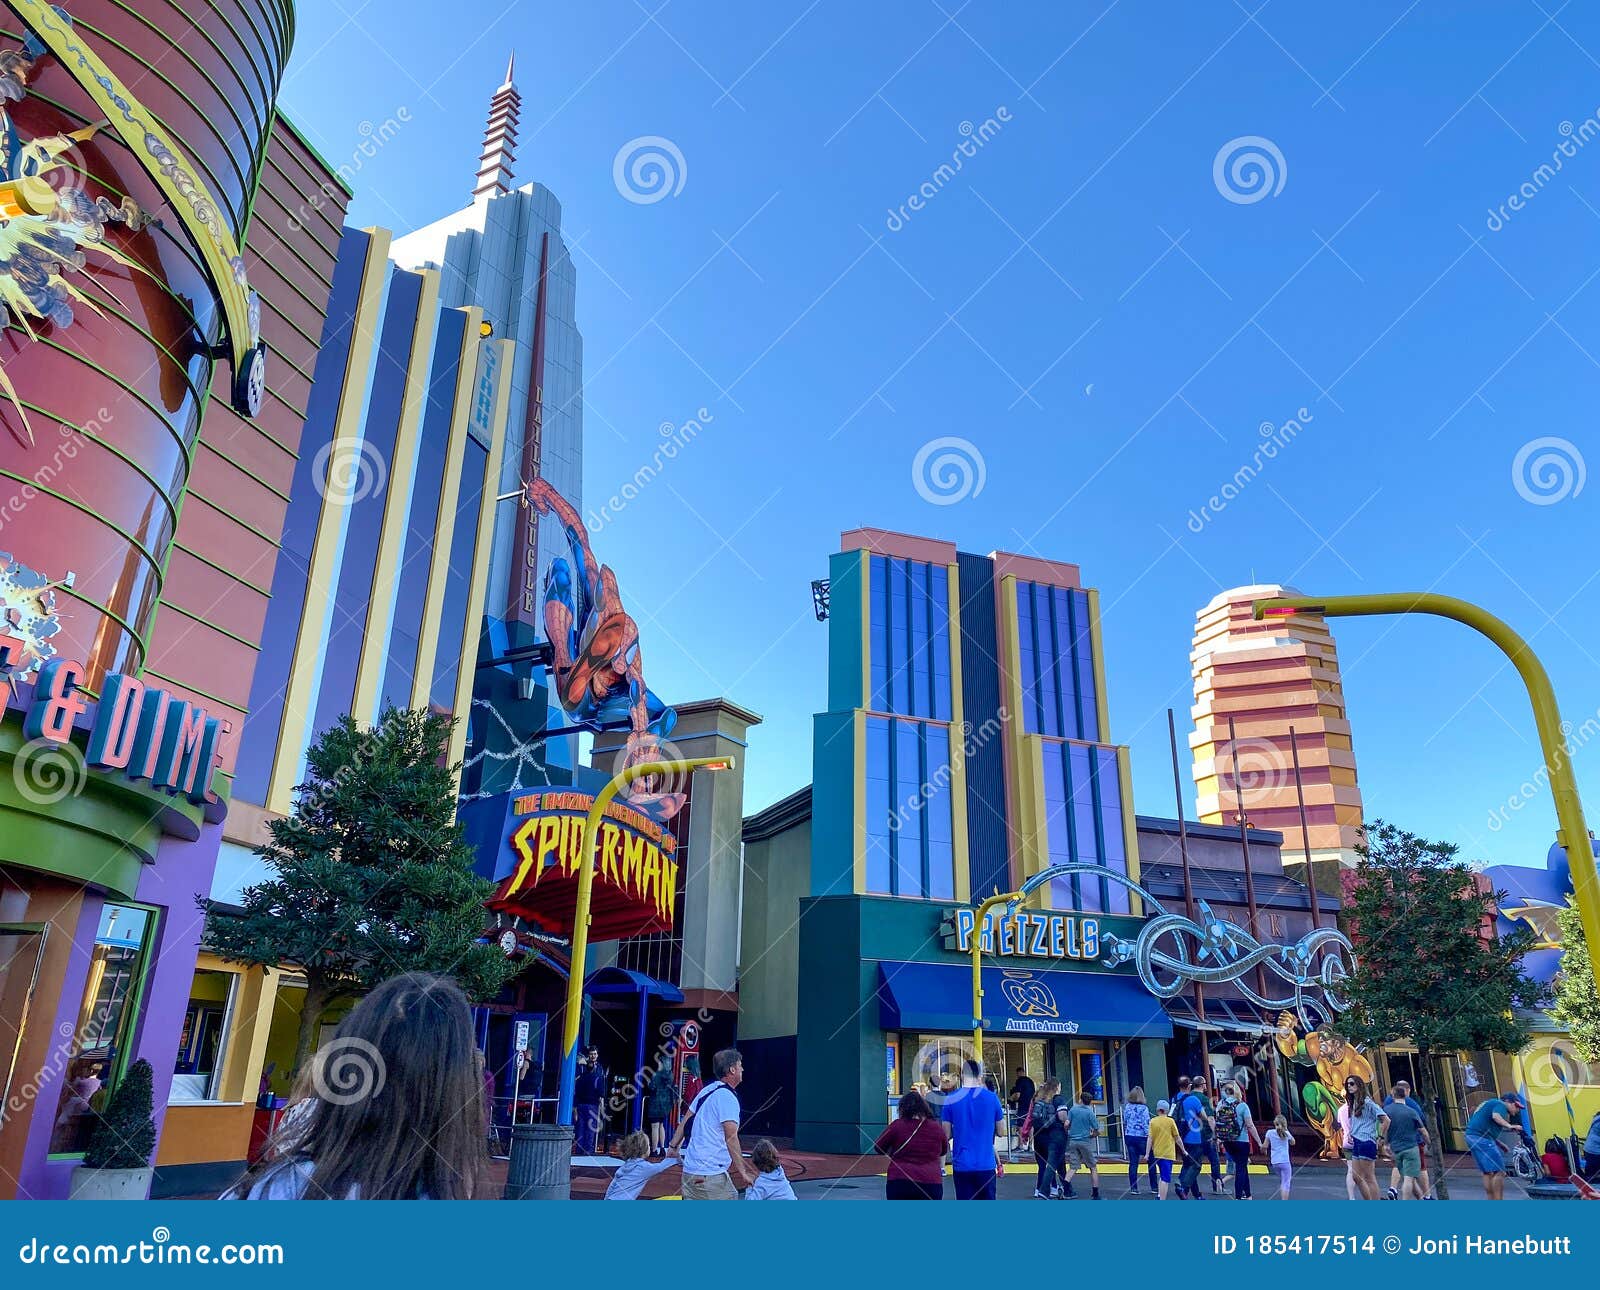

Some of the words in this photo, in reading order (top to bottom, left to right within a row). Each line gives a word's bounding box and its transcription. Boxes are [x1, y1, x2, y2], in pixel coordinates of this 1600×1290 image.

[90, 672, 232, 804] DIME
[514, 794, 541, 815] THE
[956, 909, 1100, 960] PRETZELS
